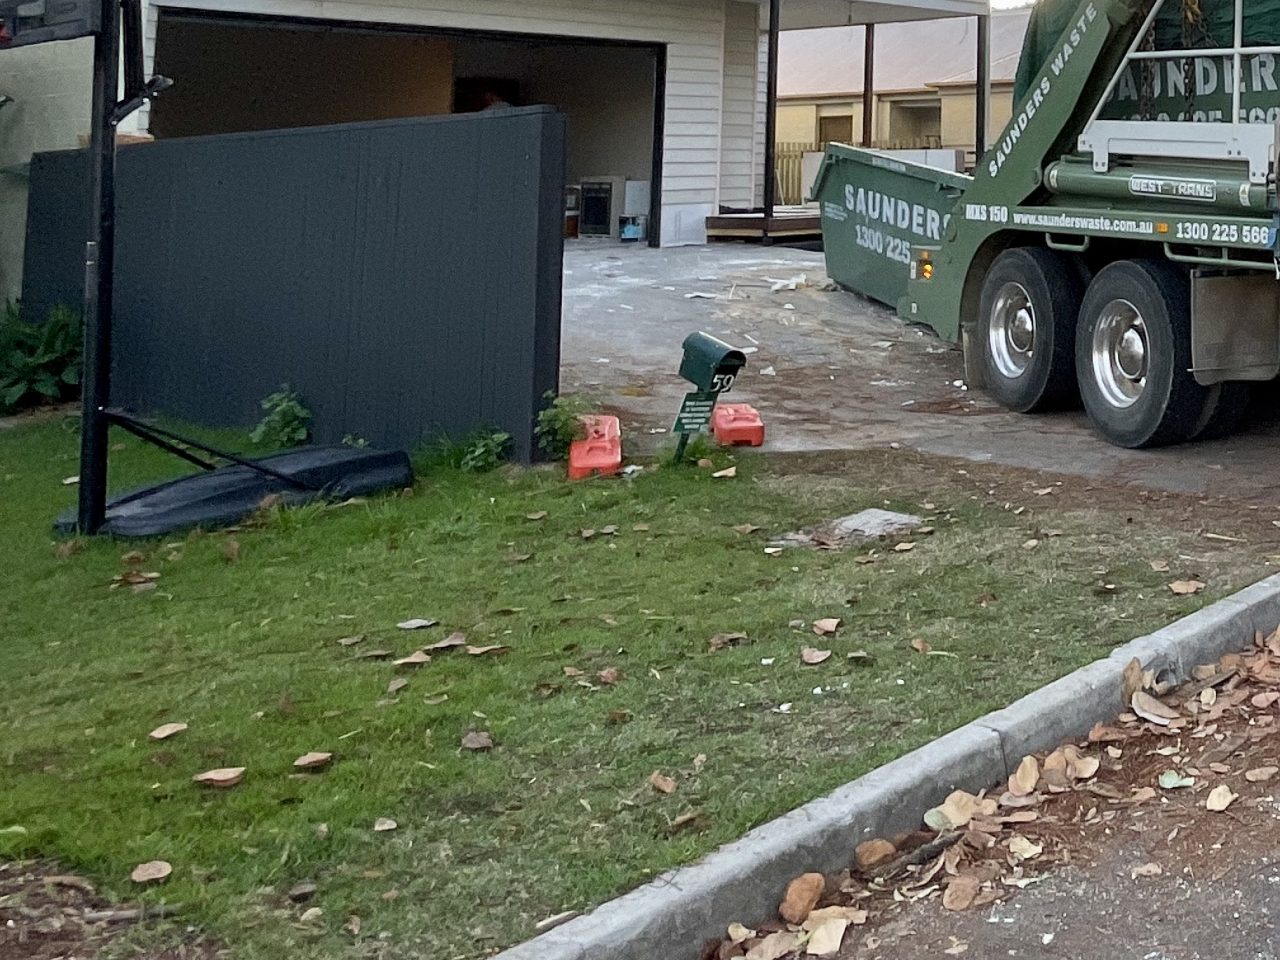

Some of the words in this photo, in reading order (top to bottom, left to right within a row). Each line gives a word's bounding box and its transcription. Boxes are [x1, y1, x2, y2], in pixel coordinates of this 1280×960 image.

[988, 76, 1051, 178] SAUNDERS
[1050, 1, 1098, 77] WASTE
[965, 204, 987, 221] MXS
[989, 205, 1008, 223] 150
[1013, 213, 1153, 234] www.saunderswaste.com.au
[1176, 222, 1208, 239] 1300
[1212, 223, 1238, 243] 225
[1242, 225, 1269, 244] 566
[855, 224, 883, 254] 1300
[886, 235, 911, 265] 225
[709, 374, 735, 393] 59
